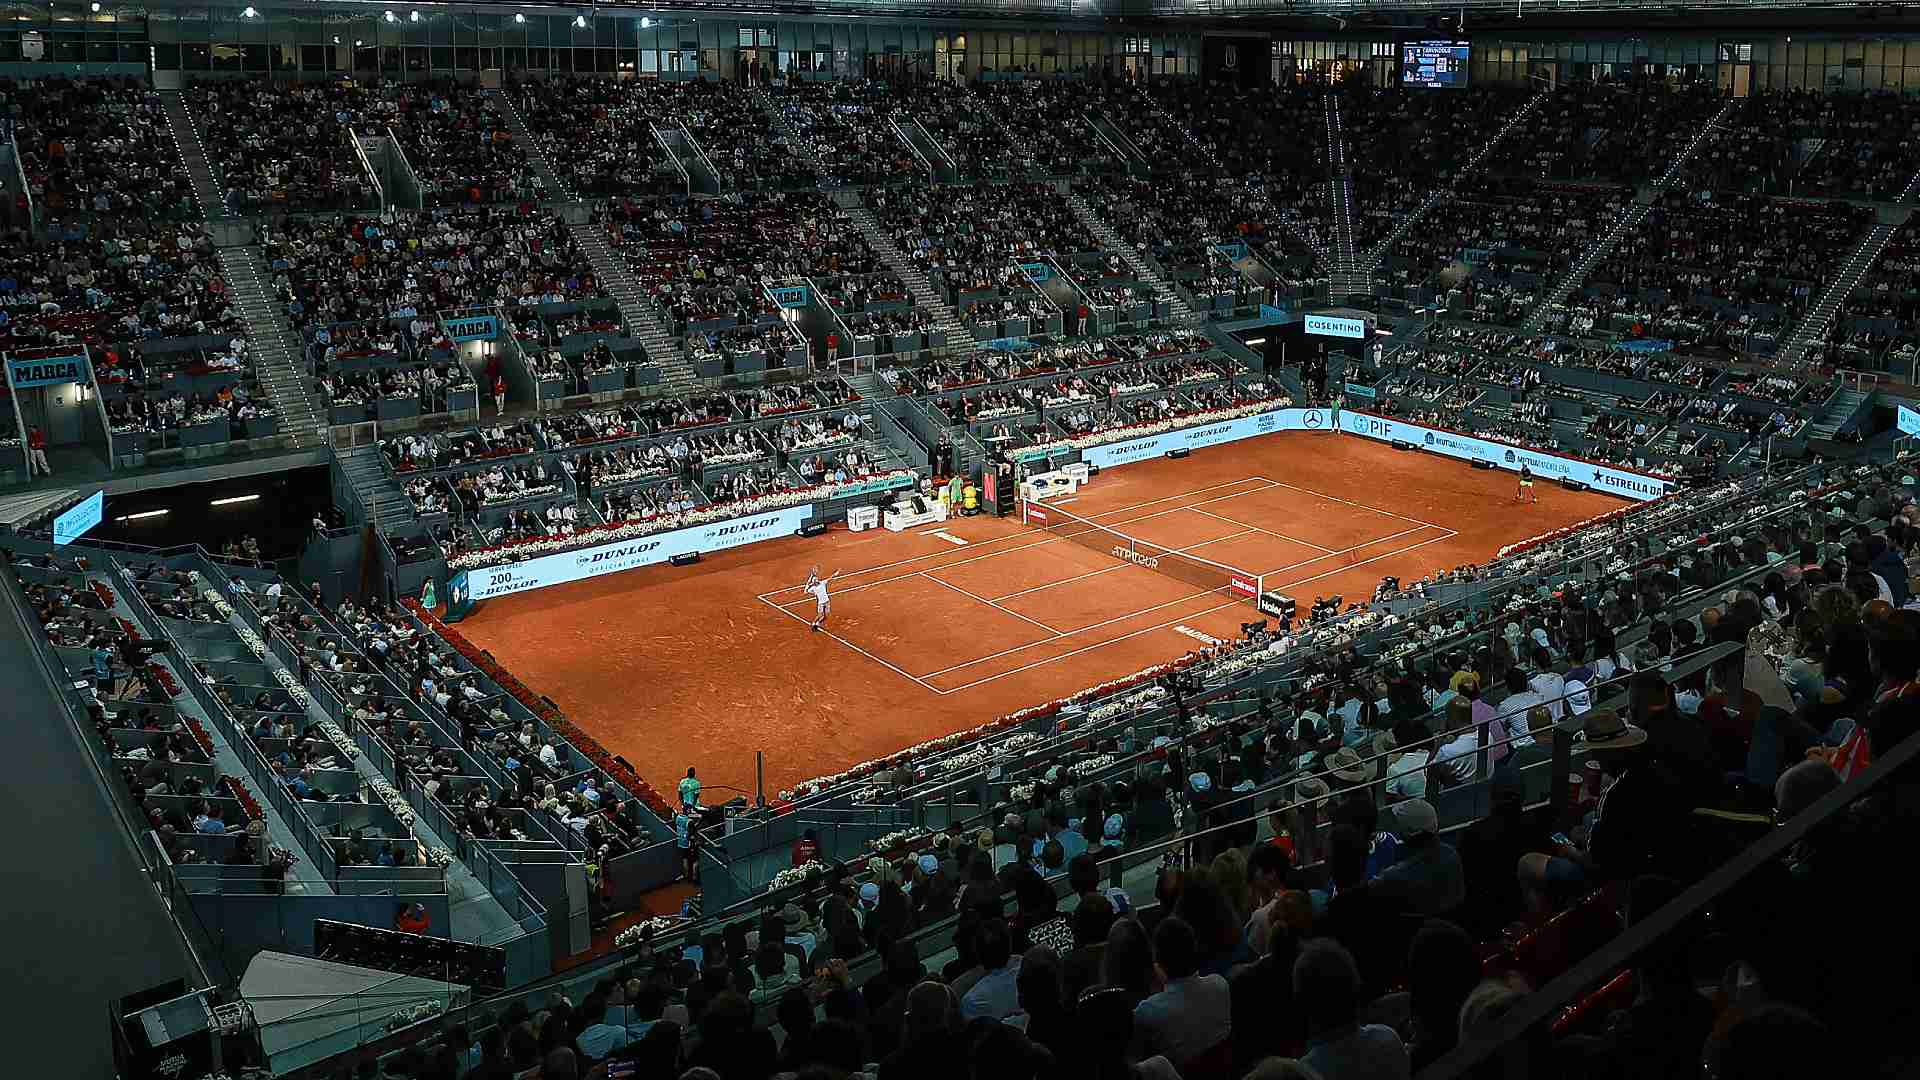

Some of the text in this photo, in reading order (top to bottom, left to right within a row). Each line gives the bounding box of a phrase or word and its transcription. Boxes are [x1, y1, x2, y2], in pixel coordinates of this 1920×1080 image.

[1308, 320, 1361, 333] COSENTINO
[15, 362, 79, 382] MARCA
[1193, 425, 1232, 439] DUNLOP
[1370, 420, 1392, 437] PIF
[1116, 440, 1158, 455] DUNLOP
[1605, 475, 1648, 494] ESTRELLA
[718, 517, 780, 537] DUNLOP
[591, 541, 661, 563] DUNLOP
[486, 579, 539, 596] DUNLOP
[490, 572, 512, 586] 200
